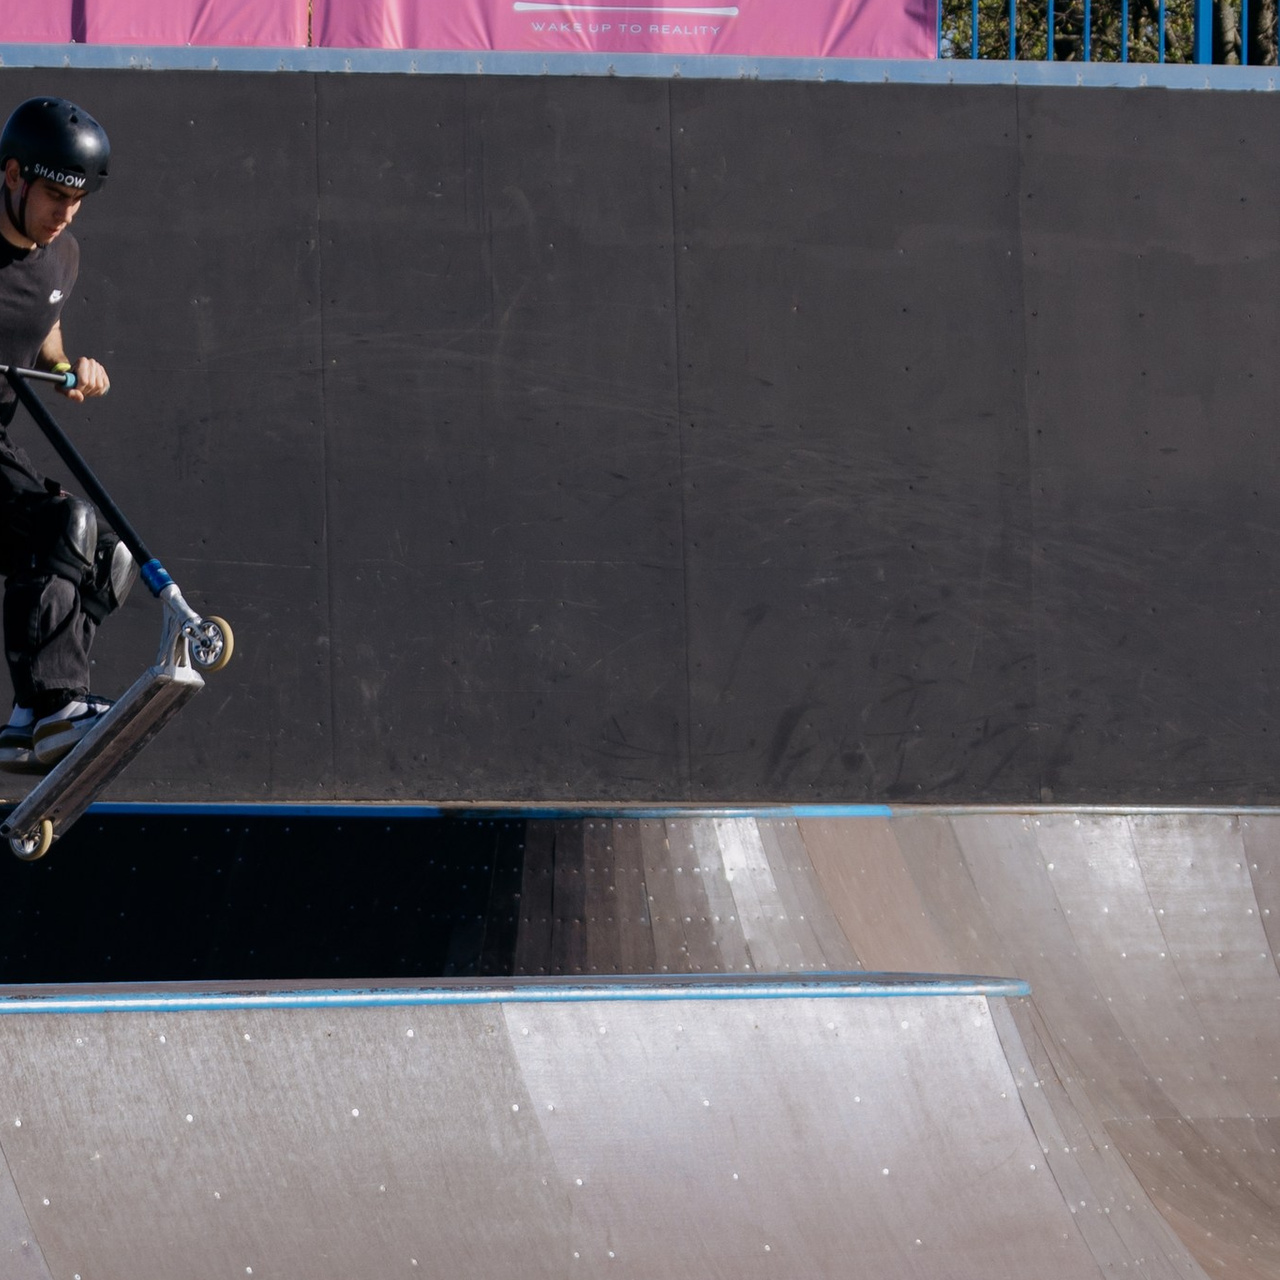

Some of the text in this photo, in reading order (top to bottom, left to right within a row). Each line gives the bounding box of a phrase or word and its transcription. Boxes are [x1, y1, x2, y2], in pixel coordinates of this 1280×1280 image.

[531, 22, 721, 35] WAKE UP TO REALITY
[34, 163, 86, 188] SHADOW
